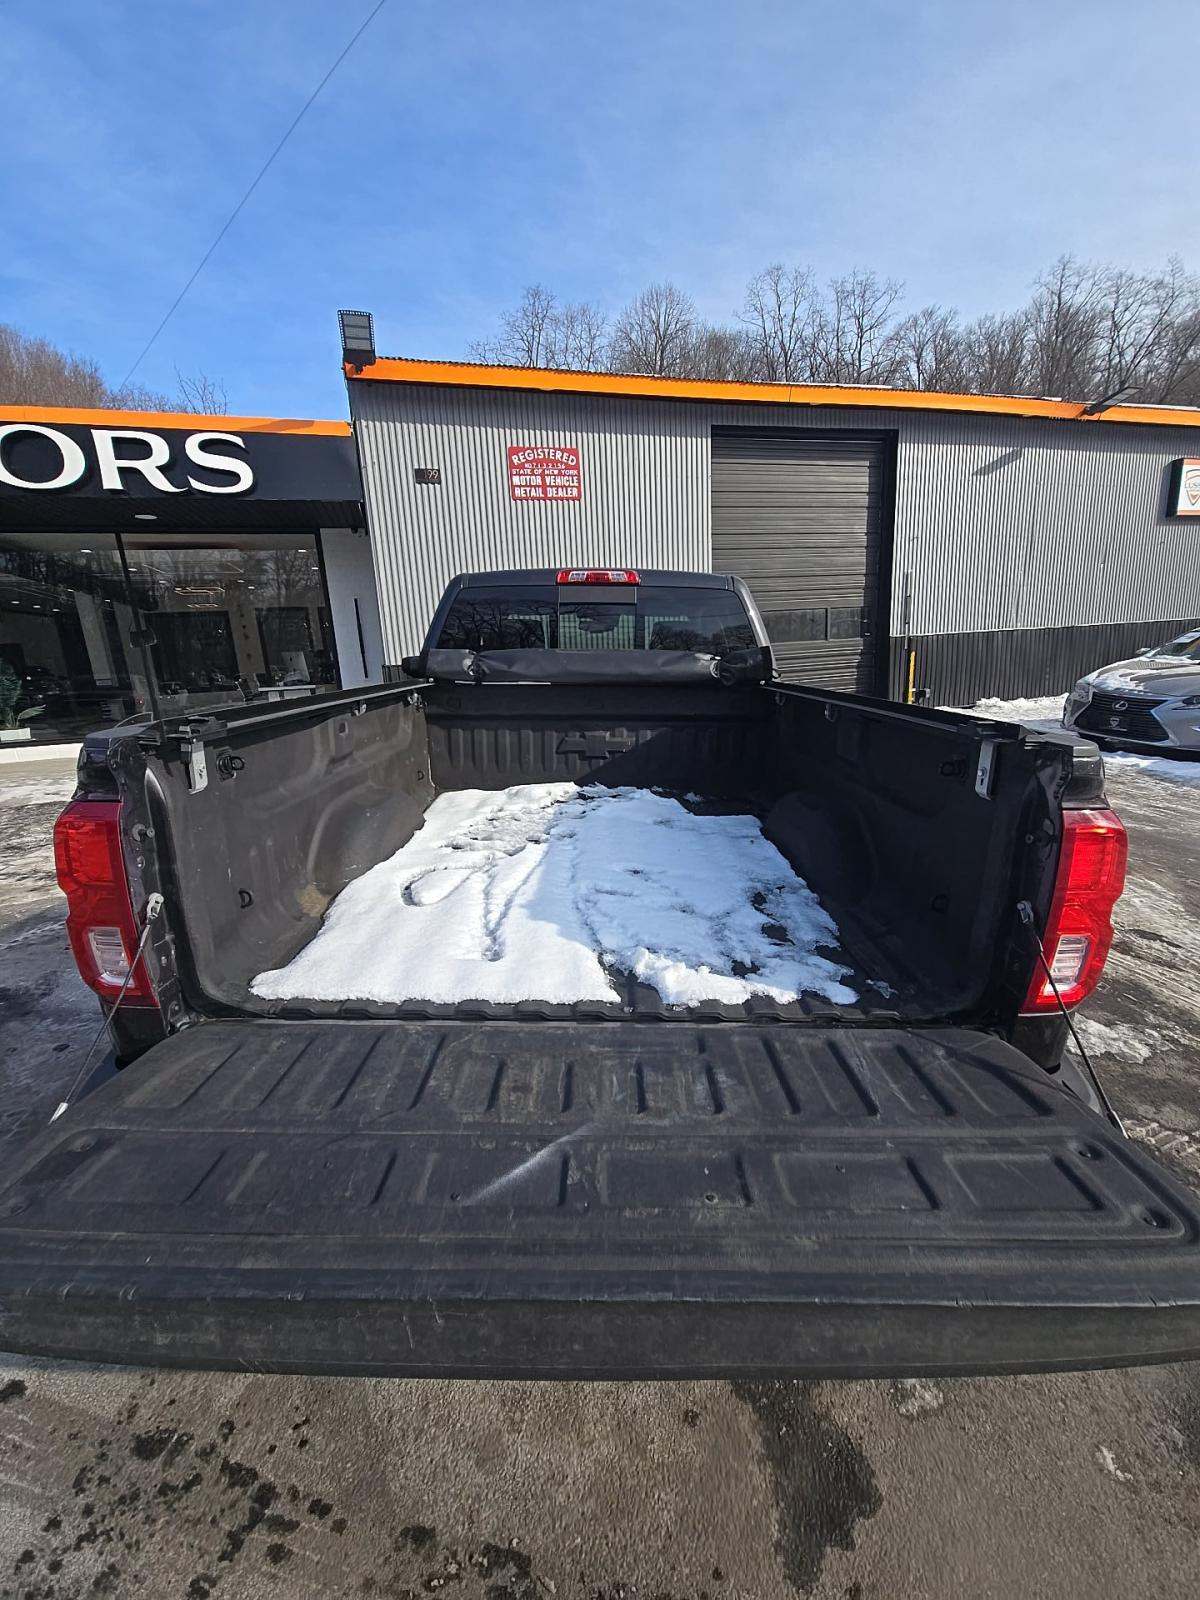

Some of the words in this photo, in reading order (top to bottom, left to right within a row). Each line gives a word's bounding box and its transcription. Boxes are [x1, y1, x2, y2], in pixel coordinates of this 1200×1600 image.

[0, 424, 254, 493] ORS
[512, 448, 576, 466] REGISTERED
[512, 475, 542, 486] MOTOR
[545, 475, 579, 486] VEHICLE
[514, 486, 544, 497] RETAIL
[546, 487, 578, 498] DEALER
